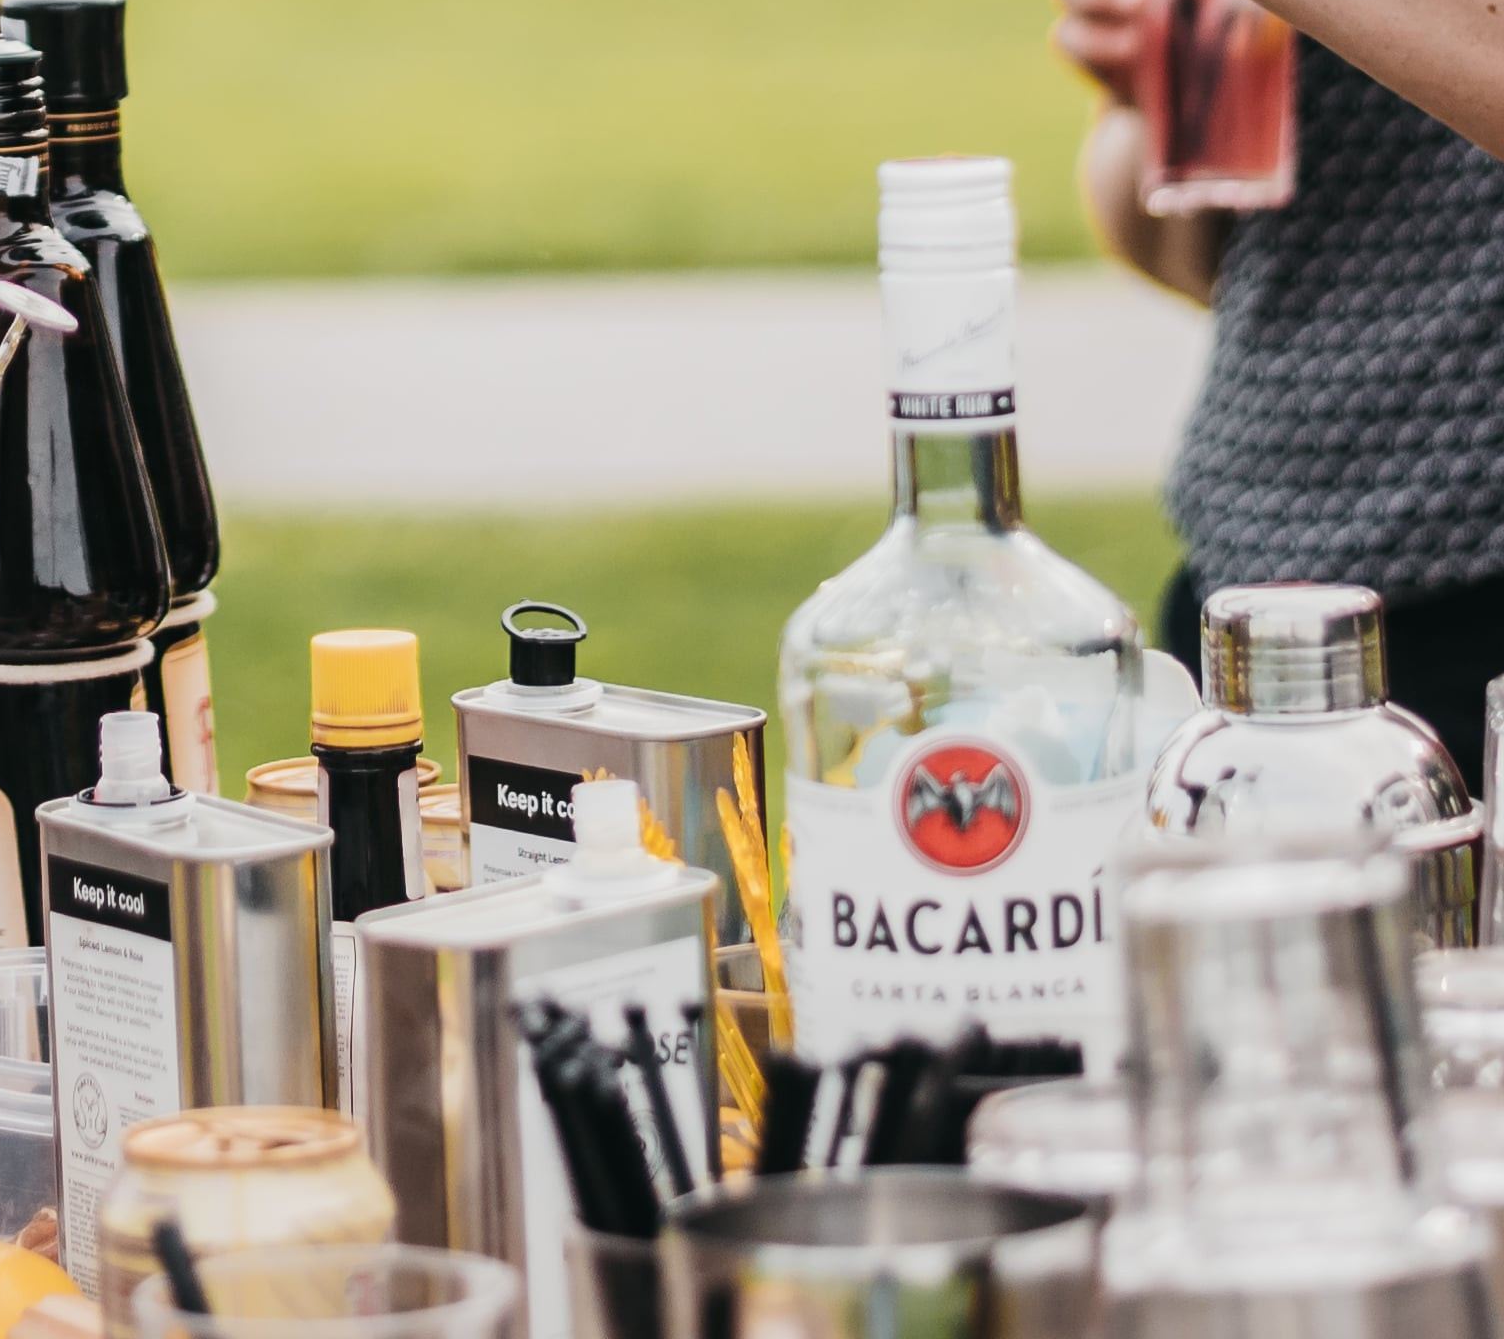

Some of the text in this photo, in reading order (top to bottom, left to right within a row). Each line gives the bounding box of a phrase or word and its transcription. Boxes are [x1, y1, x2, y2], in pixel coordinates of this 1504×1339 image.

[899, 393, 992, 418] WHITE RUM
[497, 783, 575, 818] Keep it co
[518, 847, 546, 863] Straight
[73, 876, 145, 915] Keep it cool
[832, 865, 1104, 955] BACARDÍ
[79, 935, 100, 952] Spiced
[101, 944, 123, 956] Lemon
[851, 975, 1087, 1003] CARTA BLANCA
